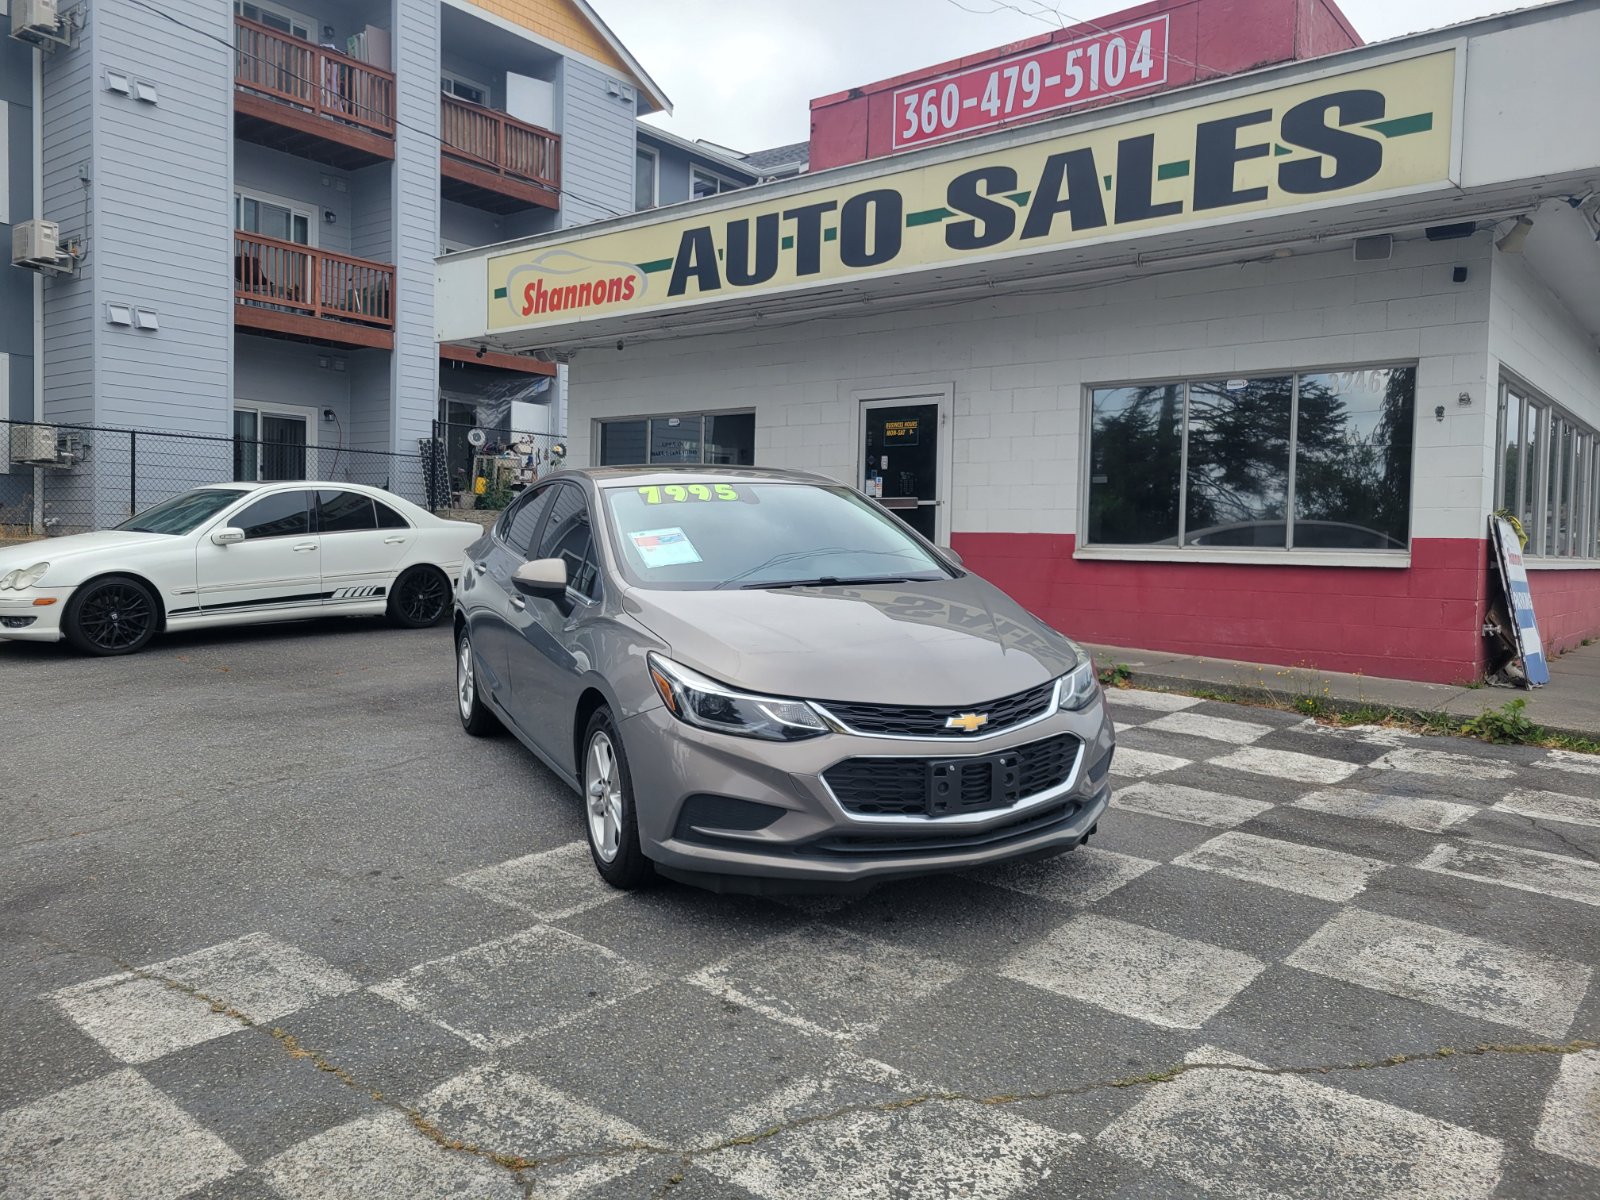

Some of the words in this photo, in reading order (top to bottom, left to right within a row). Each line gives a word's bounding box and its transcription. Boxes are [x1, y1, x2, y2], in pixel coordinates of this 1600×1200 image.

[903, 30, 1153, 138] 360-479-5104
[668, 190, 903, 297] AUTO
[945, 91, 1383, 250] SALES
[522, 275, 636, 316] Shannons
[639, 484, 738, 505] 7995
